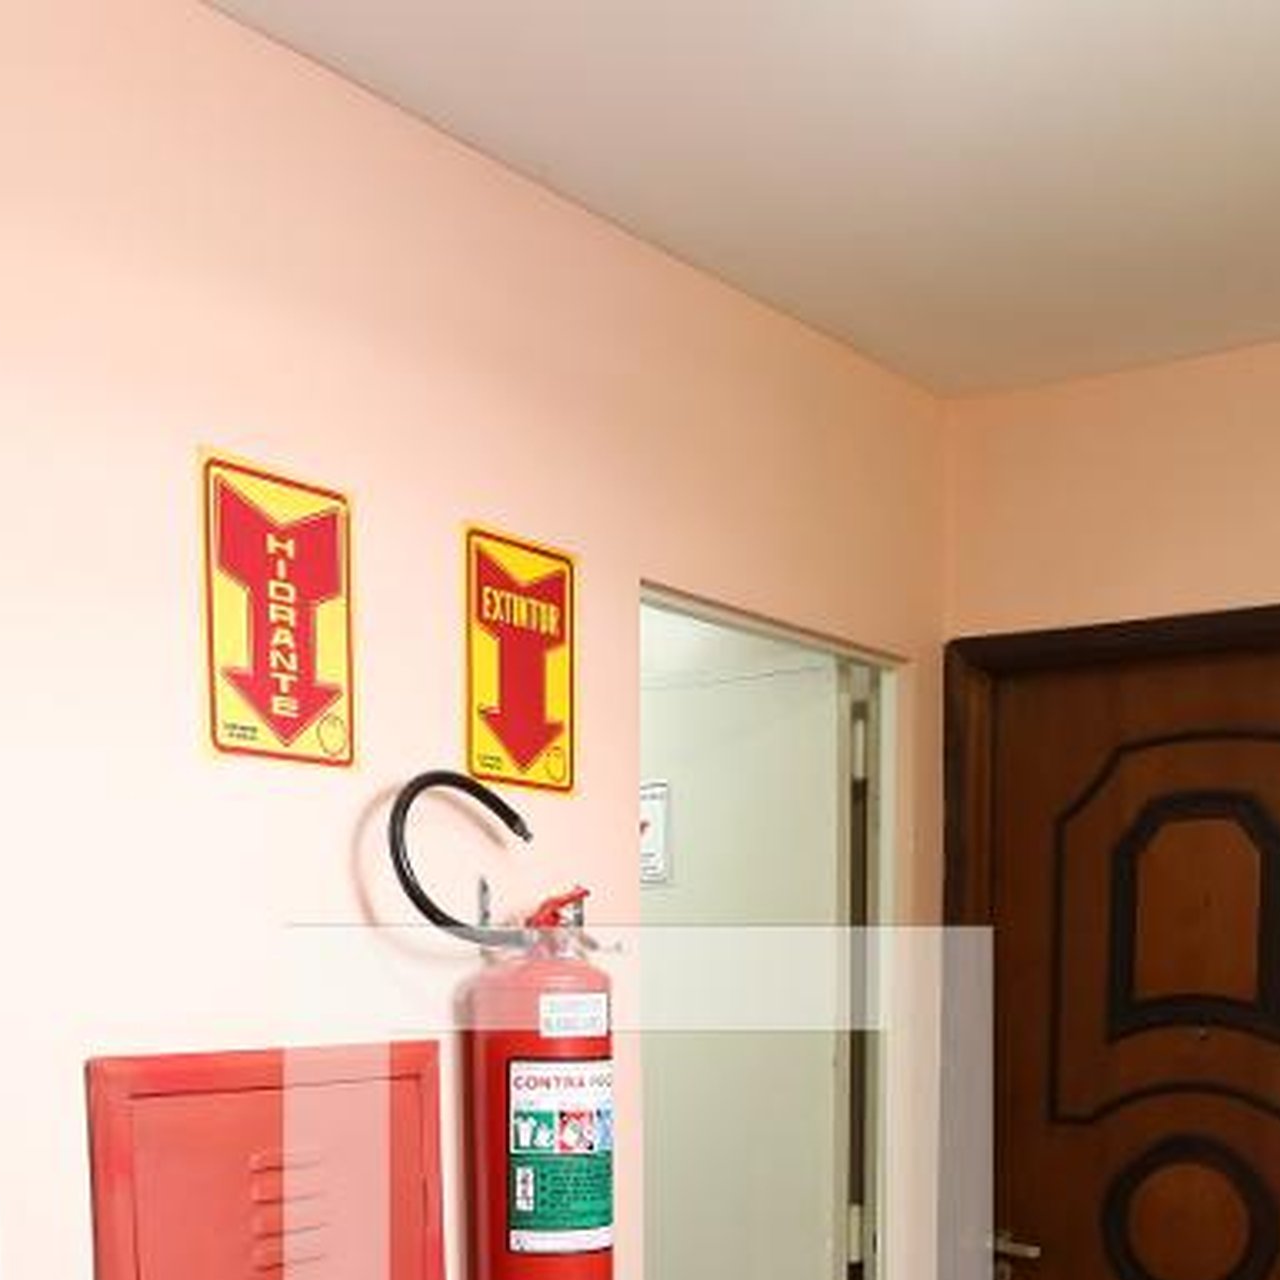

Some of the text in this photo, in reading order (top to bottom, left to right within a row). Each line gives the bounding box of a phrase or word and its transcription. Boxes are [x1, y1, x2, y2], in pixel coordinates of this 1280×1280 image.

[266, 533, 299, 719] HIDRANTE
[482, 586, 561, 637] EXTINTOR
[513, 1074, 585, 1091] CONTRA
